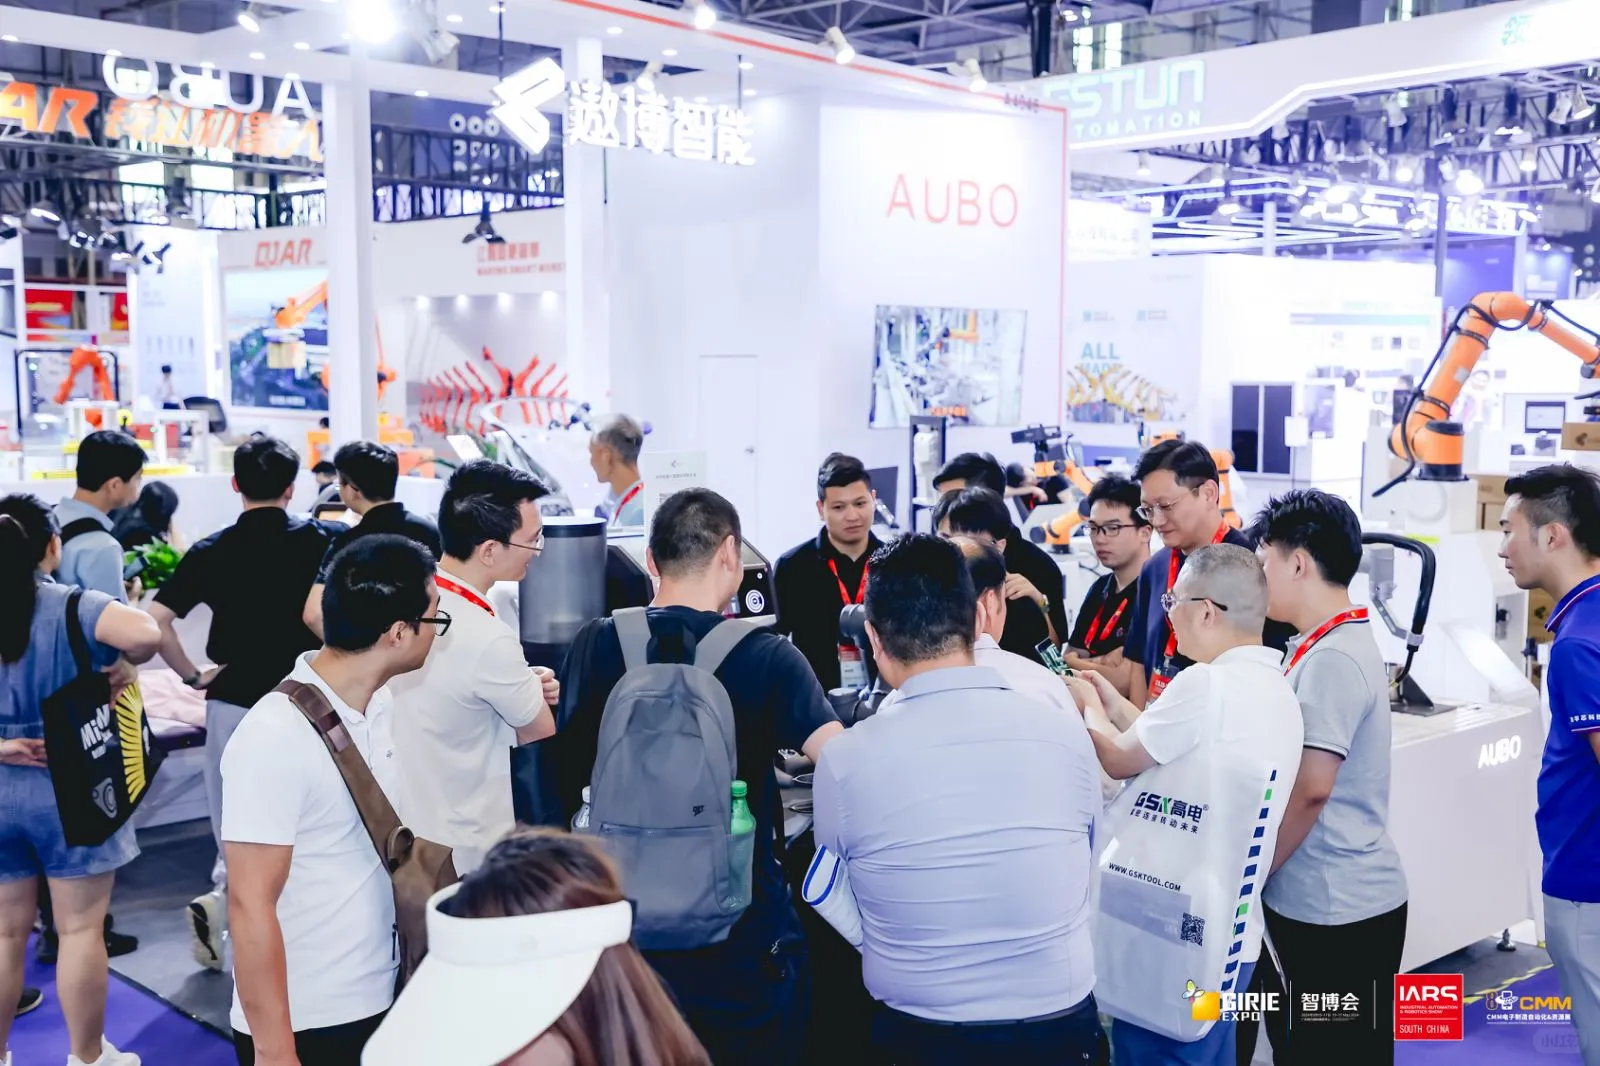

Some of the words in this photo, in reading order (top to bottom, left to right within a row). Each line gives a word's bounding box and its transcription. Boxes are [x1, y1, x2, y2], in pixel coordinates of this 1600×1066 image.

[886, 174, 1018, 228] AUBO
[1081, 343, 1120, 360] ALL
[1478, 734, 1521, 768] AUBO
[1108, 862, 1181, 891] WWW.GSKTOOL.COM
